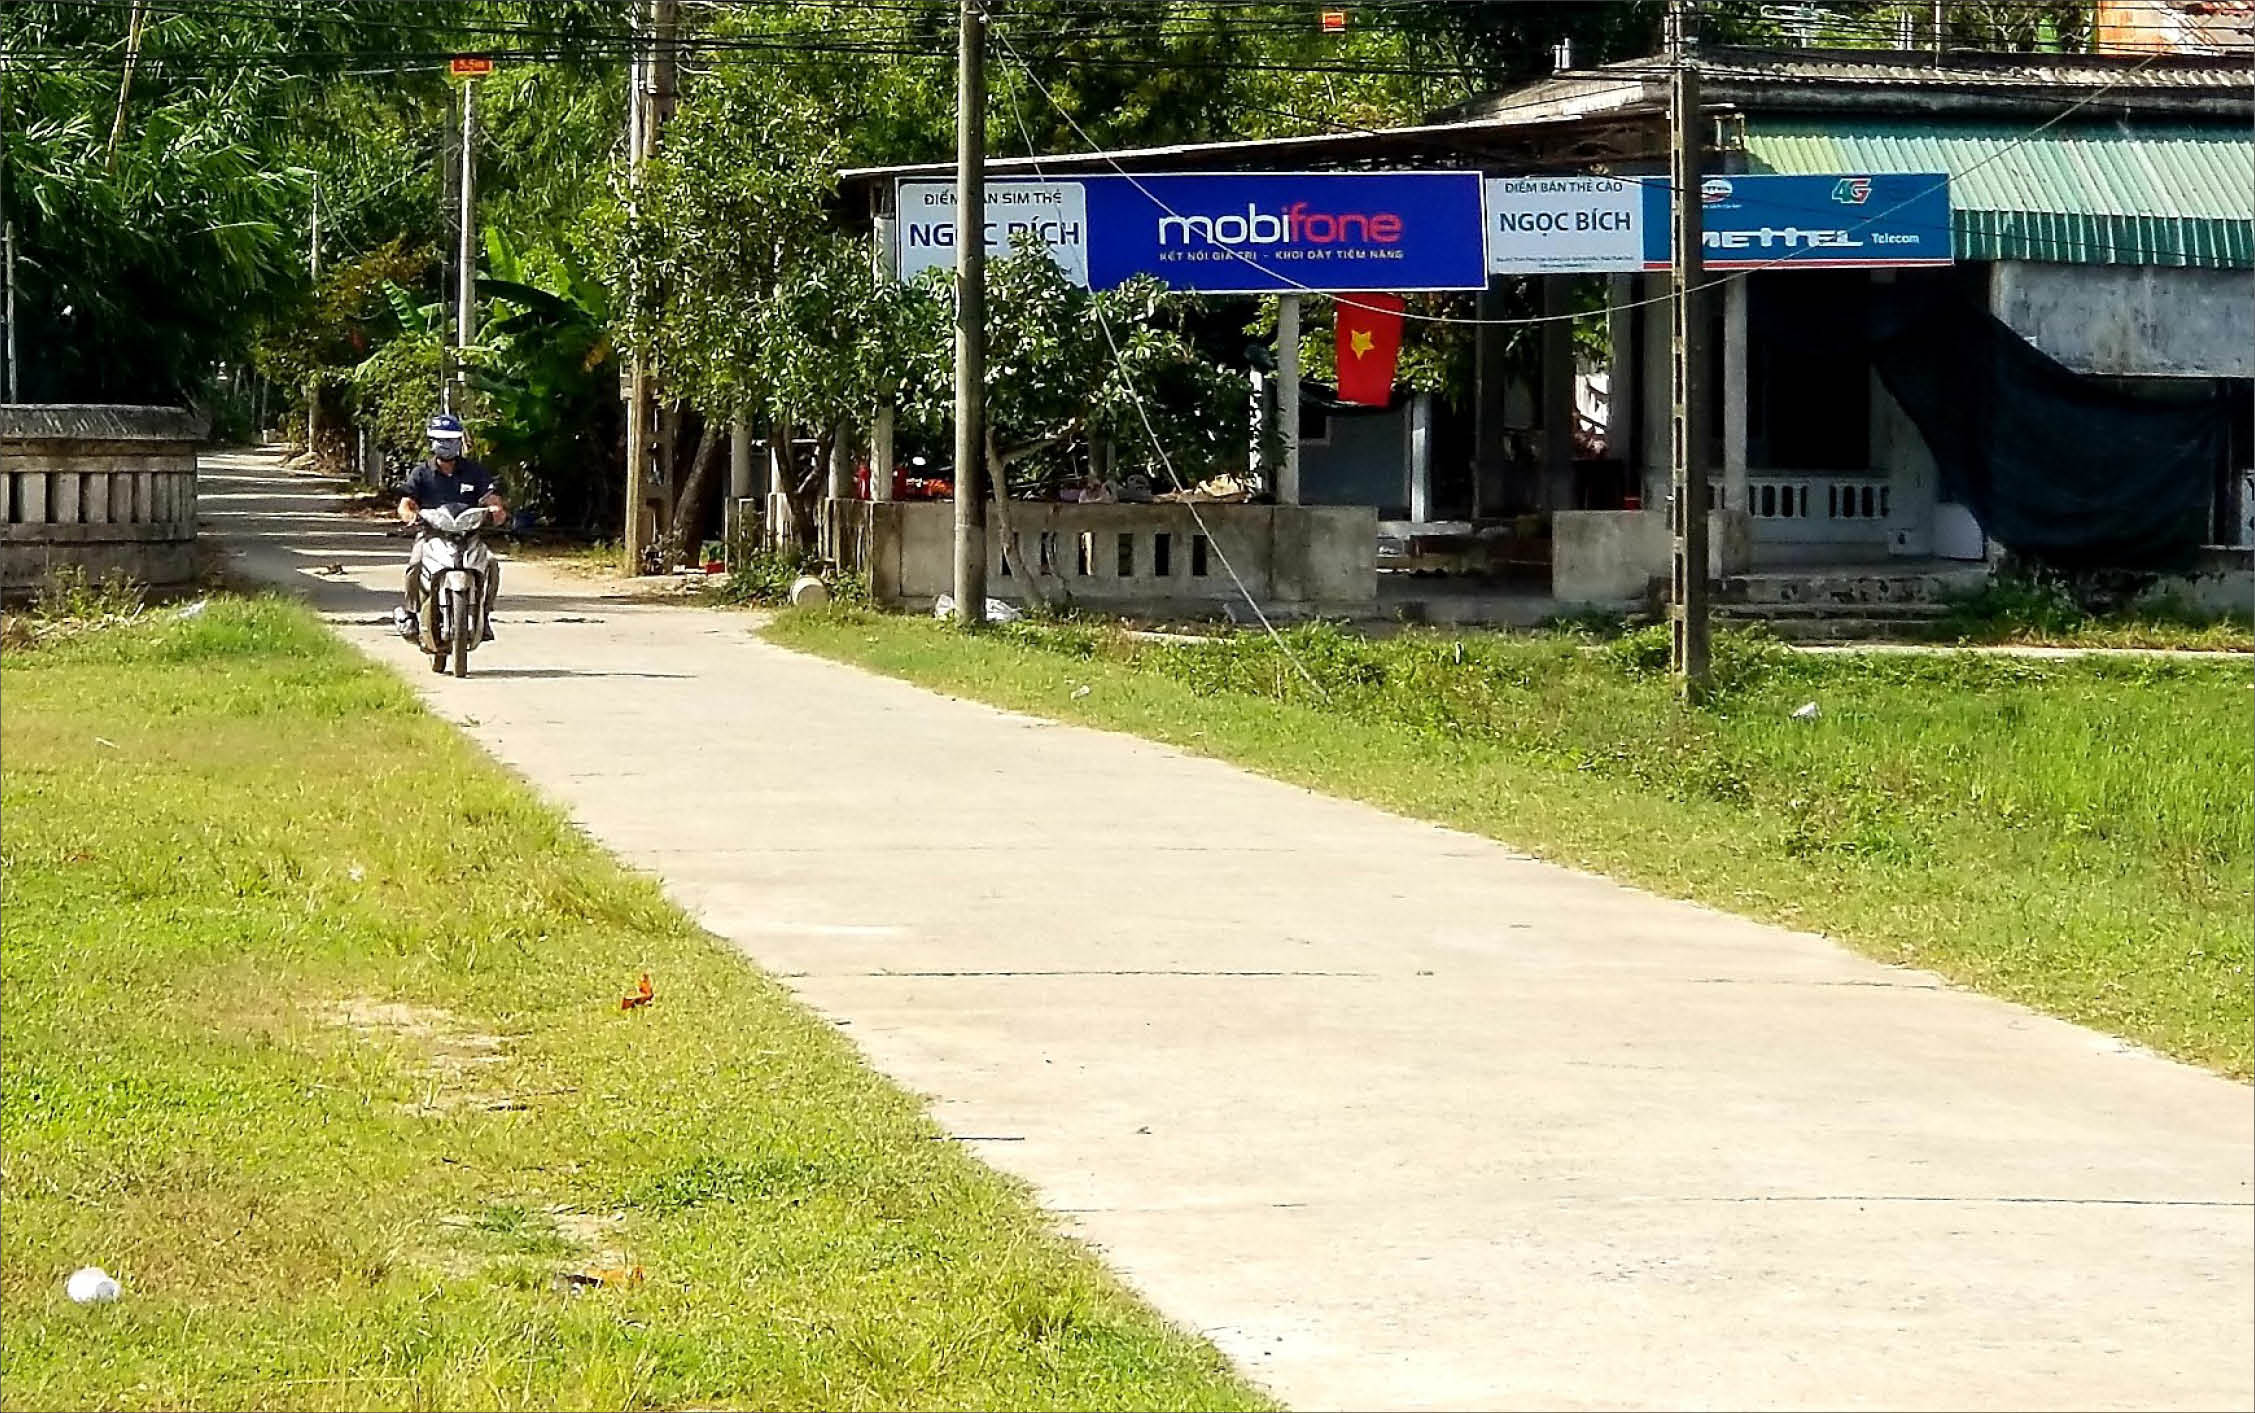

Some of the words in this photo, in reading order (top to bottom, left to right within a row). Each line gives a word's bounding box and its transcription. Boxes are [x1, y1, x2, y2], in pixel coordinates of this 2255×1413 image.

[1003, 192, 1029, 205] SIM
[1832, 178, 1872, 204] 4G
[1158, 202, 1403, 245] mobifone
[1500, 212, 1569, 236] NGỌC
[1575, 207, 1631, 231] BÍCH
[909, 222, 998, 247] NGC
[1871, 233, 1920, 245] Telecom
